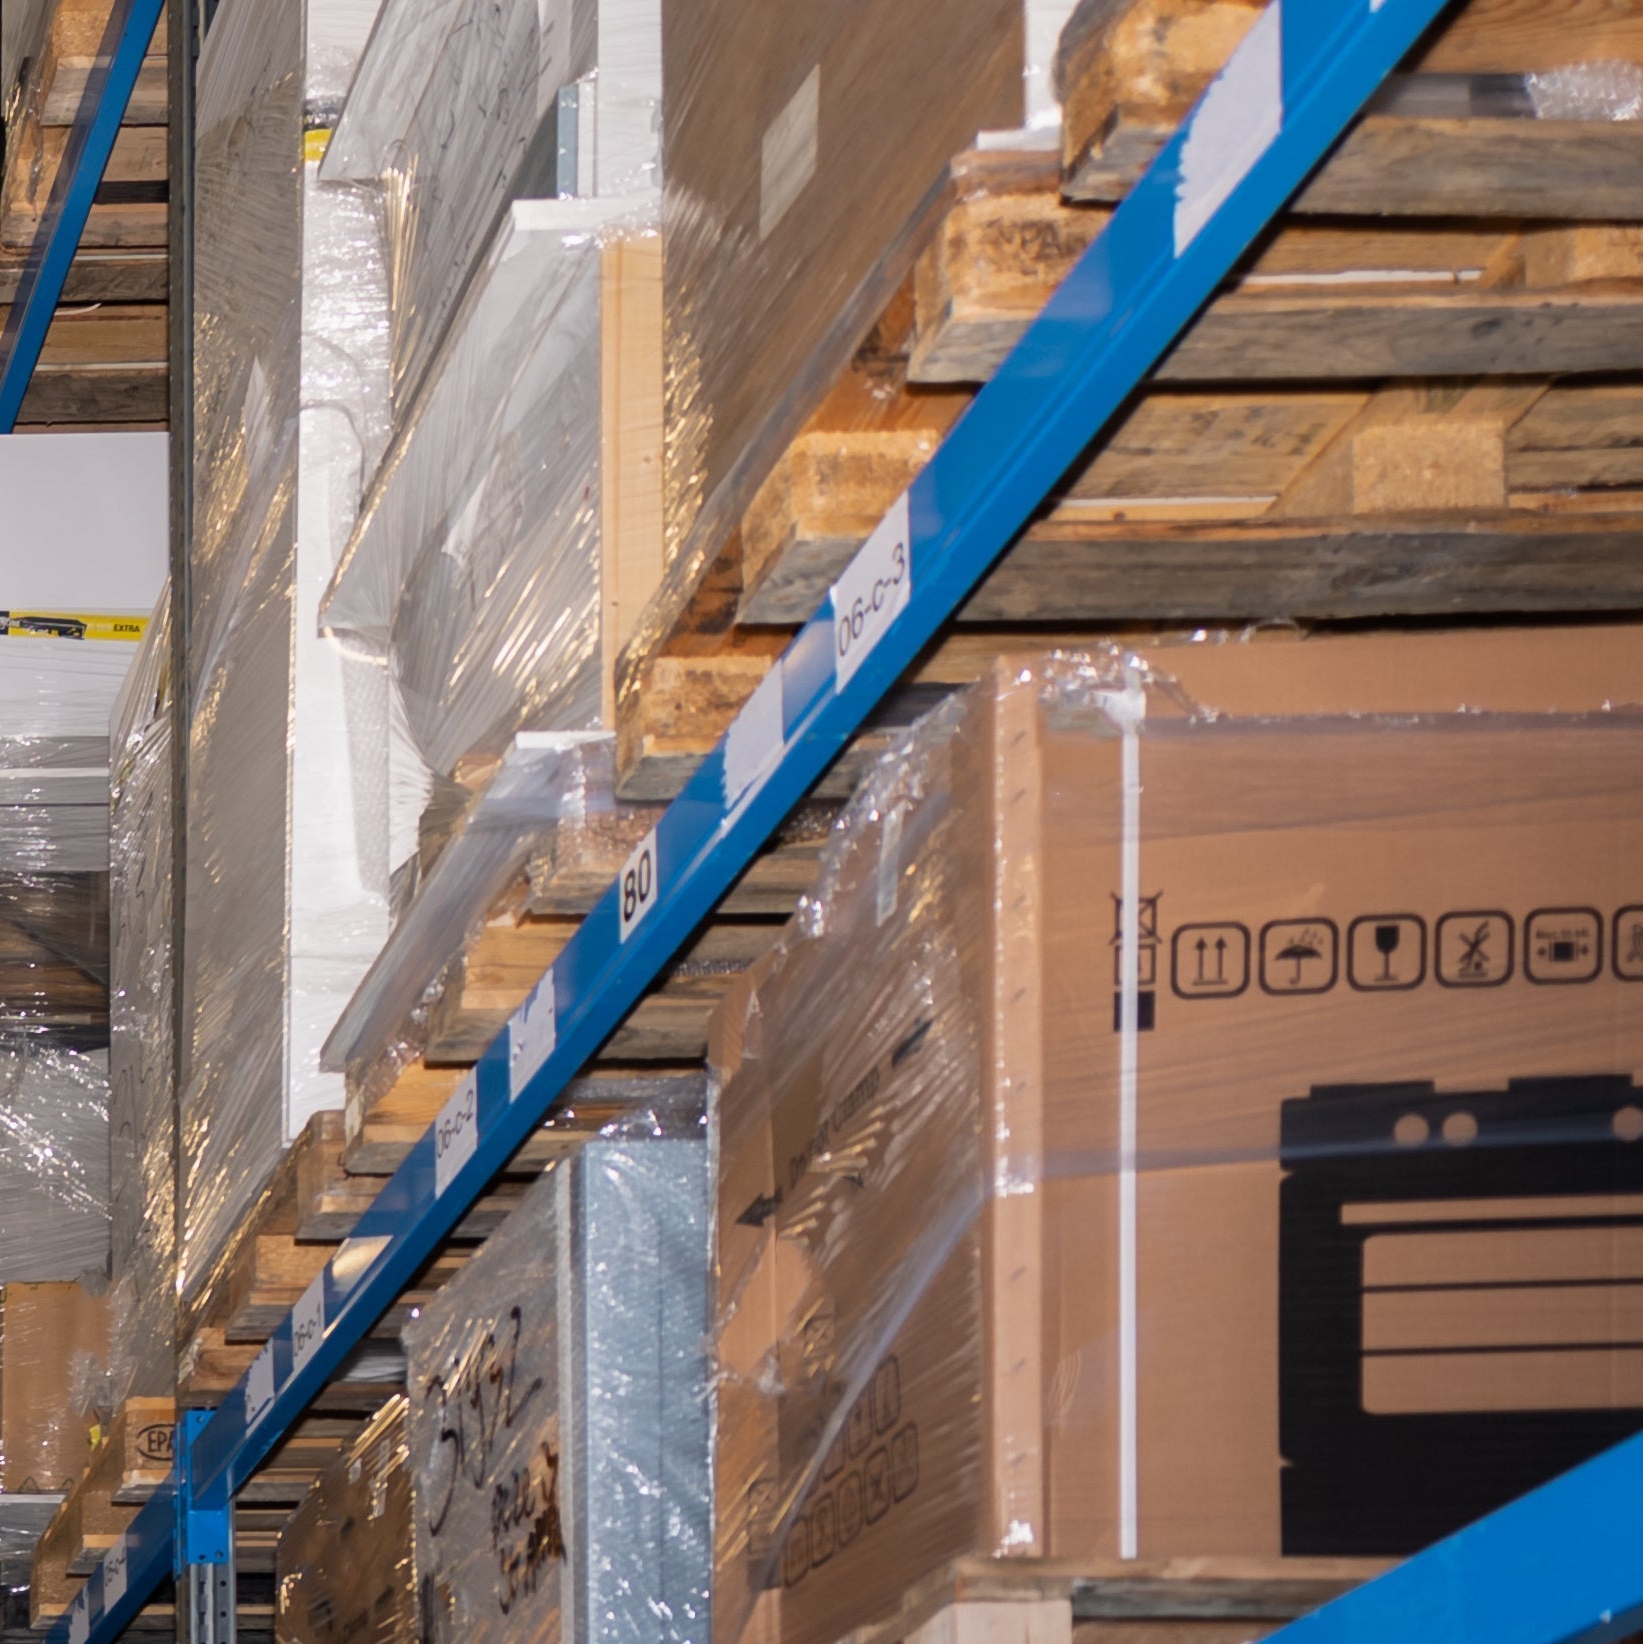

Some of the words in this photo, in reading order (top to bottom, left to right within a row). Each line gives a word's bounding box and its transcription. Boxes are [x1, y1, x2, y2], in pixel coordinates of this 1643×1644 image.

[112, 624, 141, 633] EXTRA
[839, 542, 905, 656] 06-c-3
[624, 849, 651, 923] 80
[437, 1088, 475, 1160] 06-c-2
[293, 1303, 322, 1358] 06-c-1
